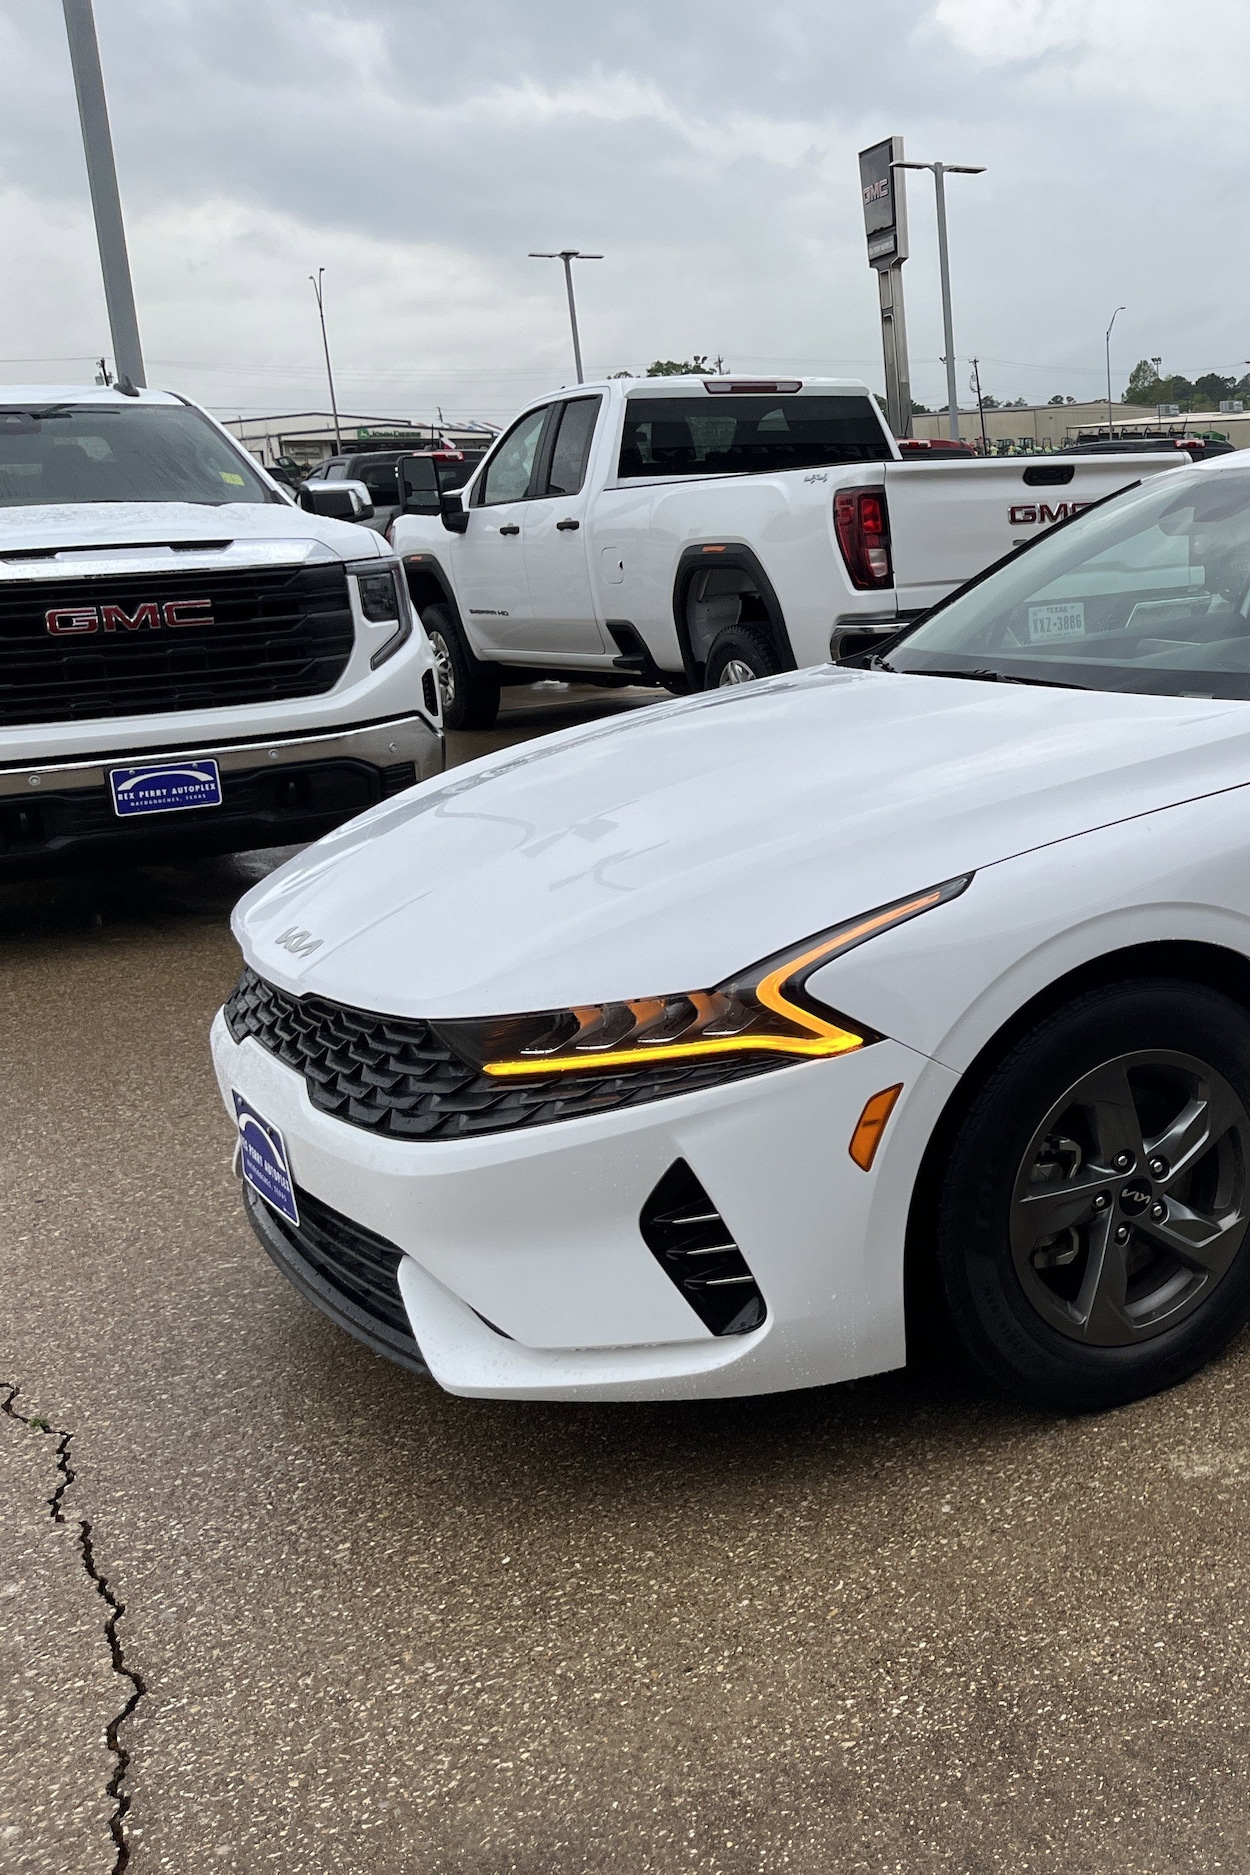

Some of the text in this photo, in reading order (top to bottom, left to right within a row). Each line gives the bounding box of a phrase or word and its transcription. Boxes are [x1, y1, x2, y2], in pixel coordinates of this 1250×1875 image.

[863, 178, 889, 204] GMC
[45, 599, 214, 636] GMC
[117, 782, 216, 801] REX PERRY AUTOPLEX
